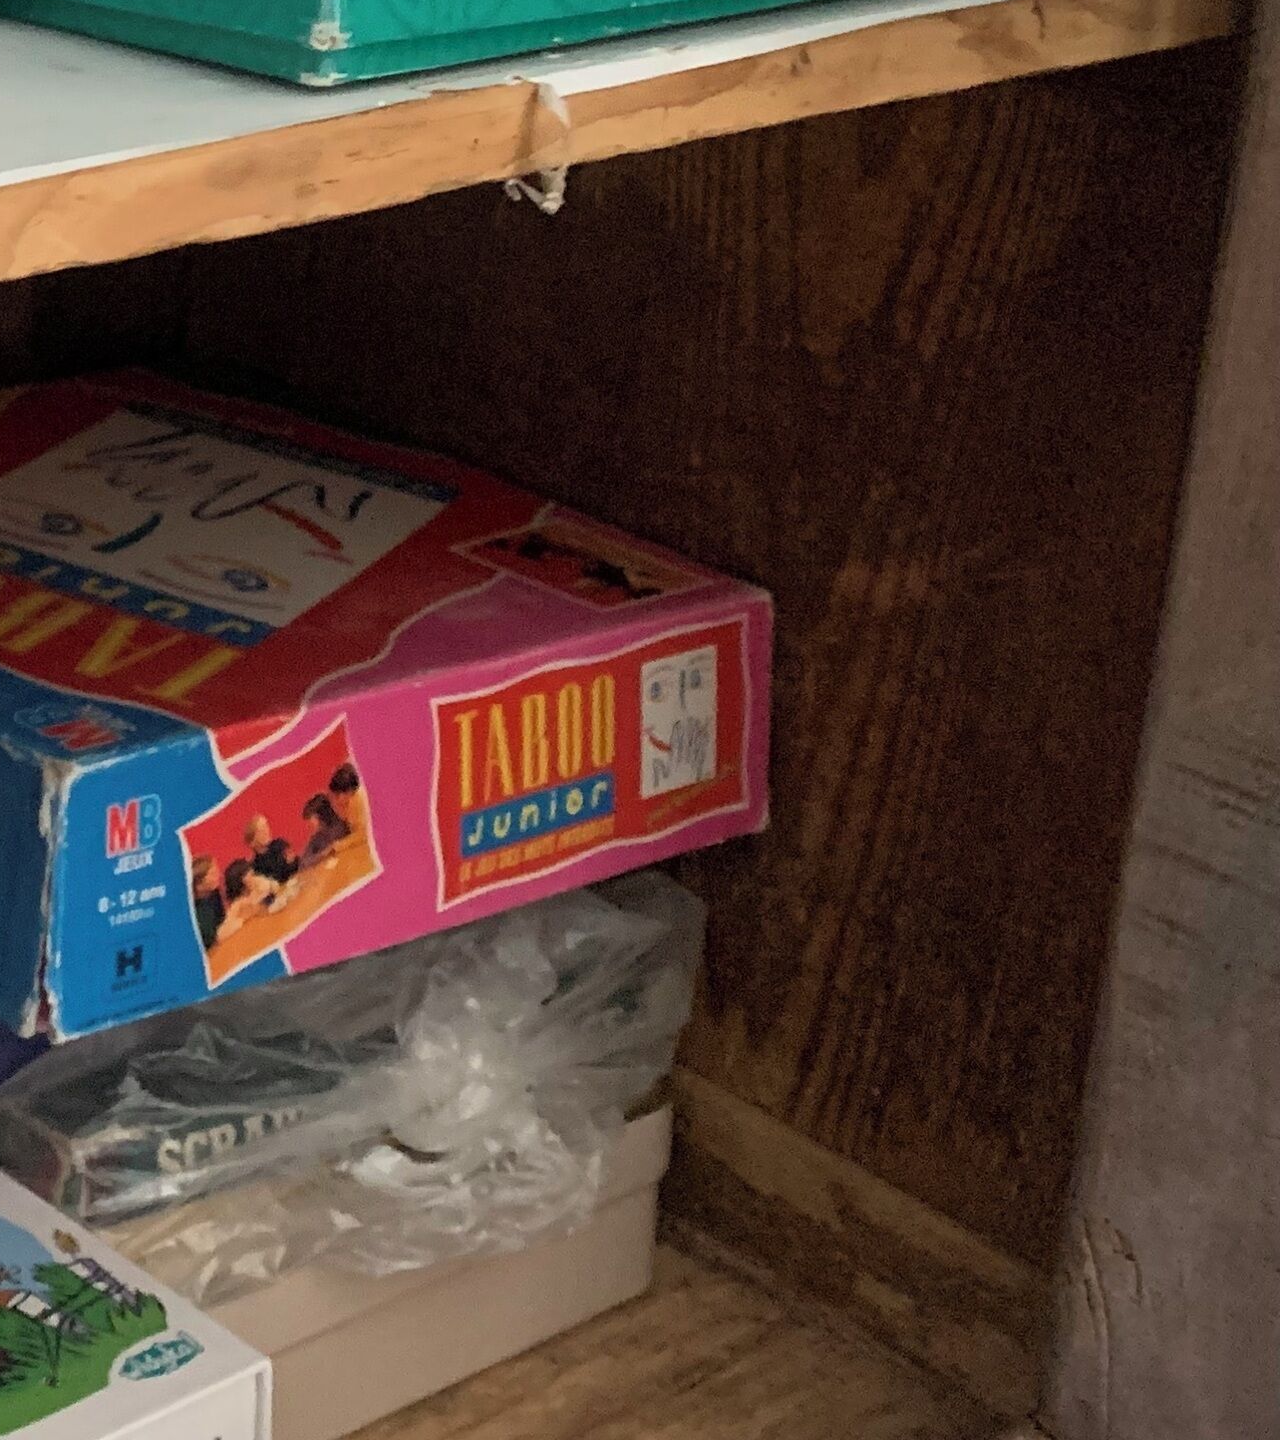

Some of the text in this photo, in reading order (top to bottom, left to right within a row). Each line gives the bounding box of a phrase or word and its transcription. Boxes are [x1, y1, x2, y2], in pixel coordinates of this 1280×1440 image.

[453, 673, 617, 809] TABOO
[105, 793, 163, 859] MB
[467, 780, 609, 847] Junior
